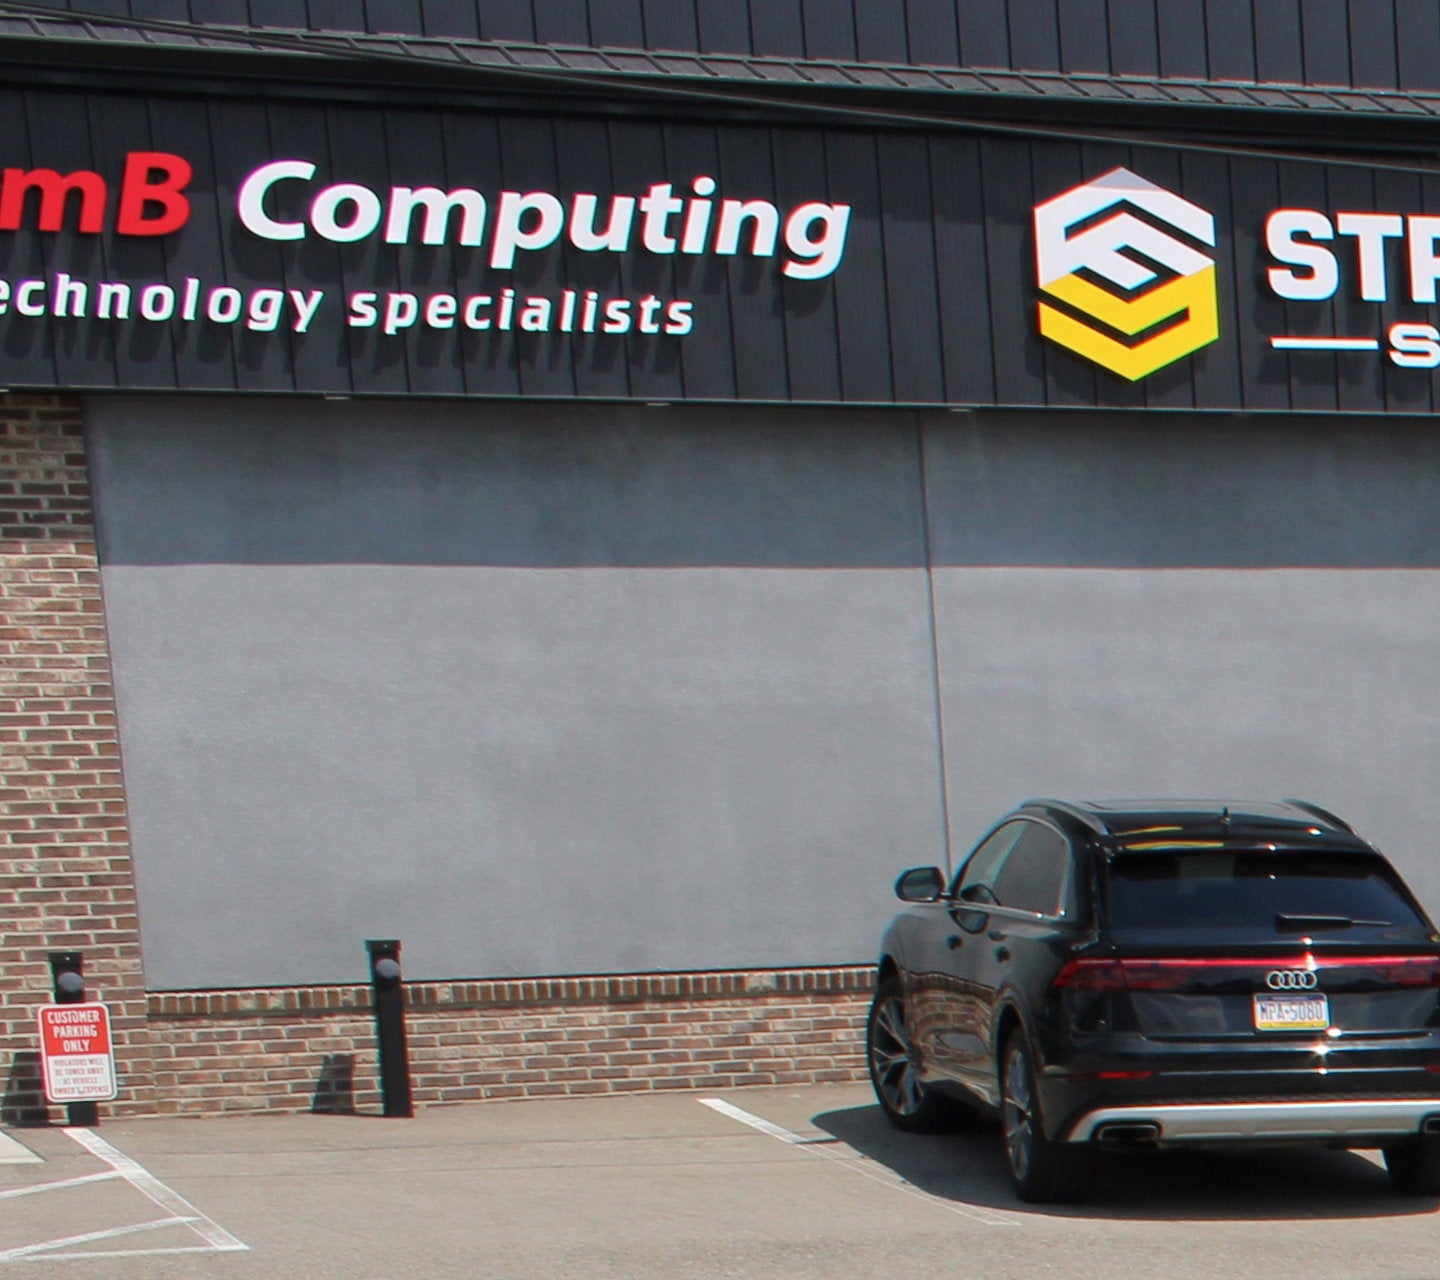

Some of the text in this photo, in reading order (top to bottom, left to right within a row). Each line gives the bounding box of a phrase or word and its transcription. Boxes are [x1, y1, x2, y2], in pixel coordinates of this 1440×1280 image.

[237, 159, 852, 280] Computing
[348, 285, 695, 335] specialists
[47, 1010, 101, 1024] CUSTOMER
[53, 1024, 98, 1038] PARKING
[63, 1039, 90, 1052] ONLY
